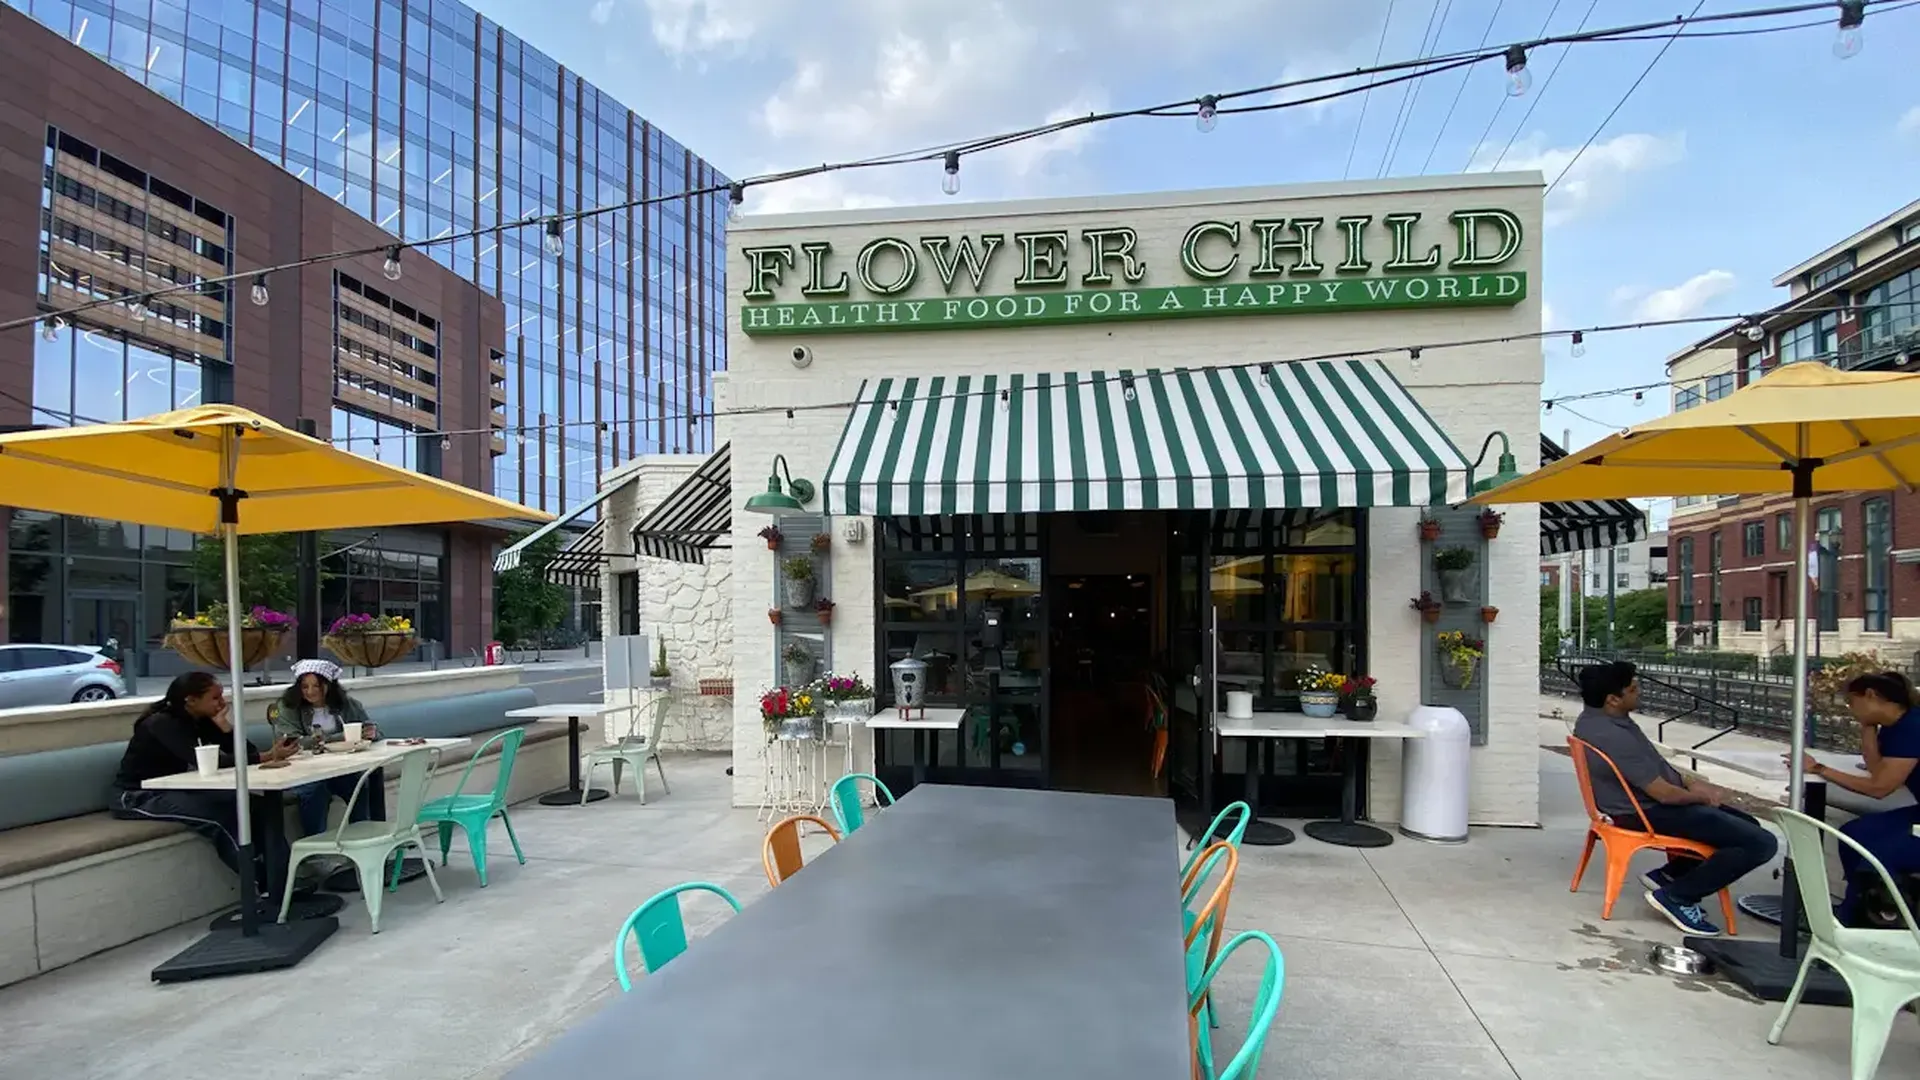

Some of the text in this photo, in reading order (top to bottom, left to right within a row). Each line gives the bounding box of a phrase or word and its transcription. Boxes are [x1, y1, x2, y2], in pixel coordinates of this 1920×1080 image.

[743, 208, 1523, 300] FLOWER CHILD
[747, 275, 1521, 327] HEALTHY FOOD FOR A HAPPY WORLD
